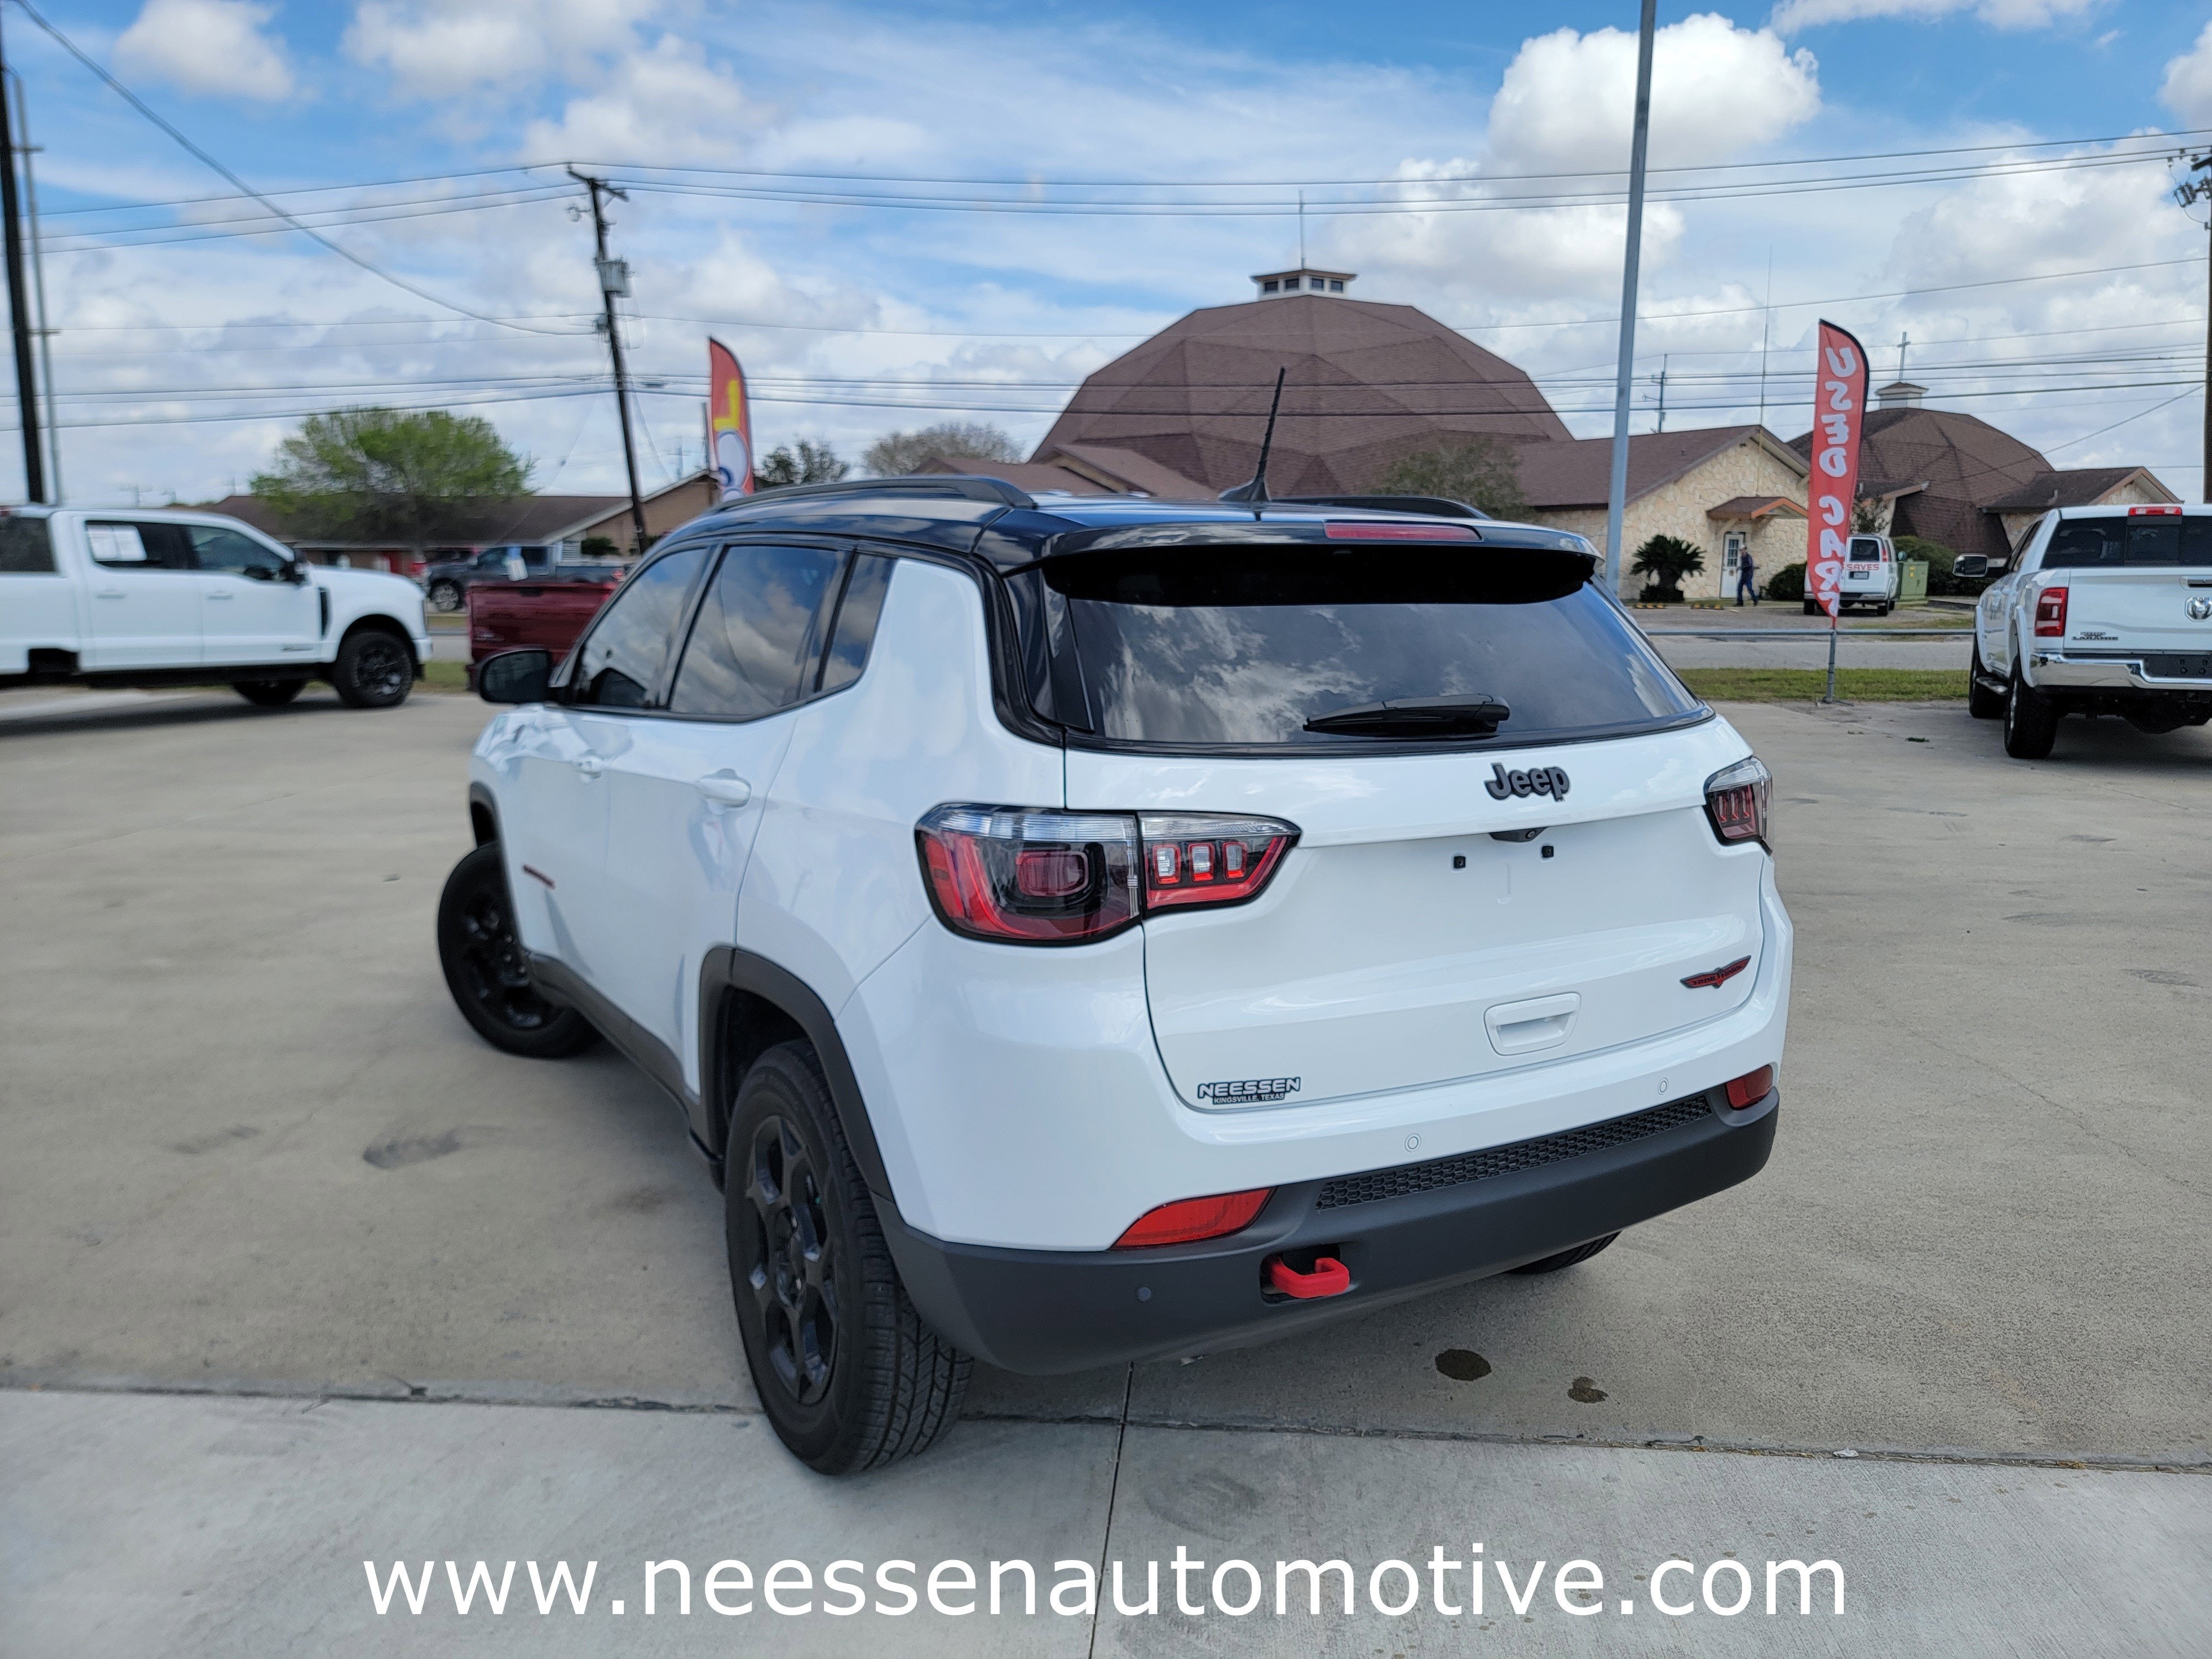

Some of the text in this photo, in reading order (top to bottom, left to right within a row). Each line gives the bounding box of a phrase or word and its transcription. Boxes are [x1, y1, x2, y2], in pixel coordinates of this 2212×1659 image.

[1484, 762, 1570, 802] Jeep
[1198, 1077, 1301, 1099] NEESSEN
[1261, 1092, 1284, 1100] TEXAS
